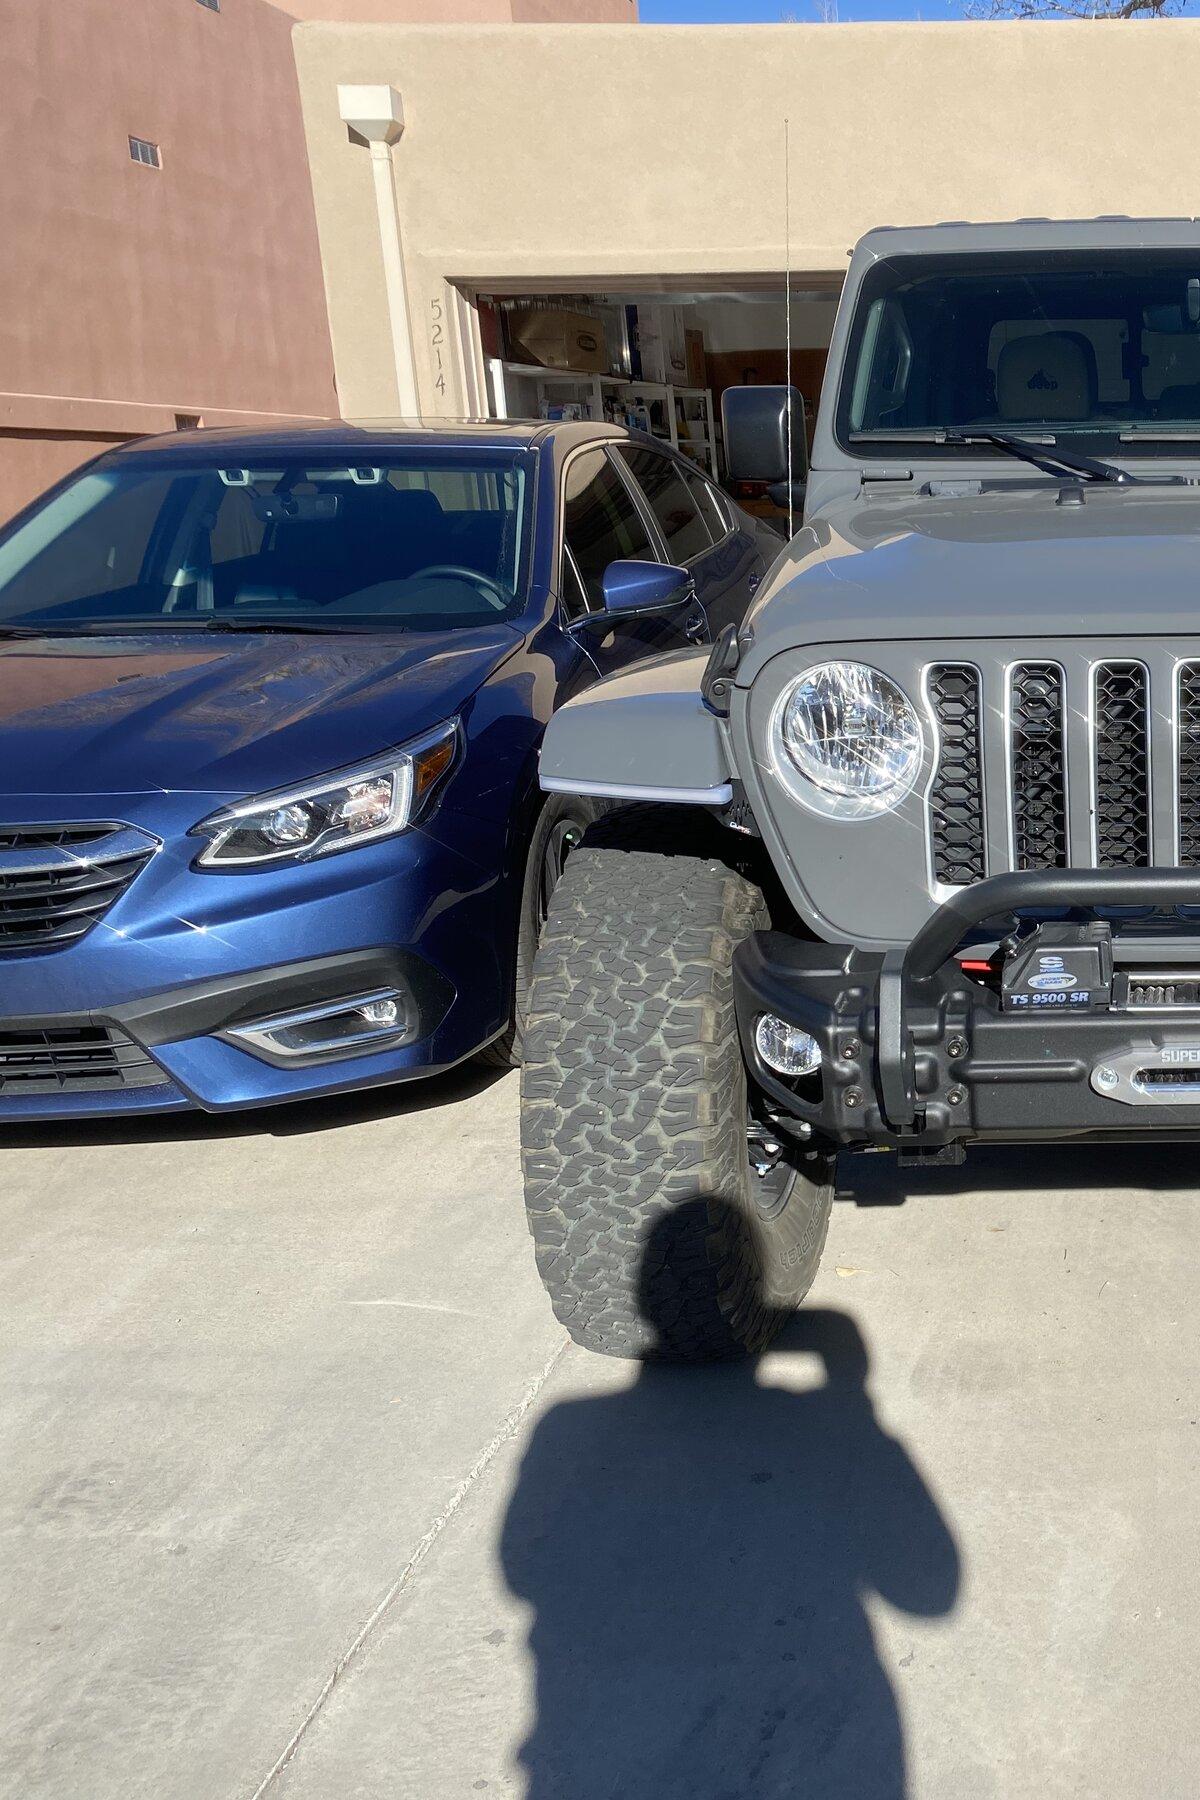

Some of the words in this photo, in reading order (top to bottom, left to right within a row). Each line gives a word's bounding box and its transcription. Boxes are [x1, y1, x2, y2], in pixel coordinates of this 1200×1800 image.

[430, 298, 446, 396] 5214
[1010, 994, 1029, 1005] TS
[1032, 992, 1067, 1004] 9500
[1069, 991, 1090, 1003] SR
